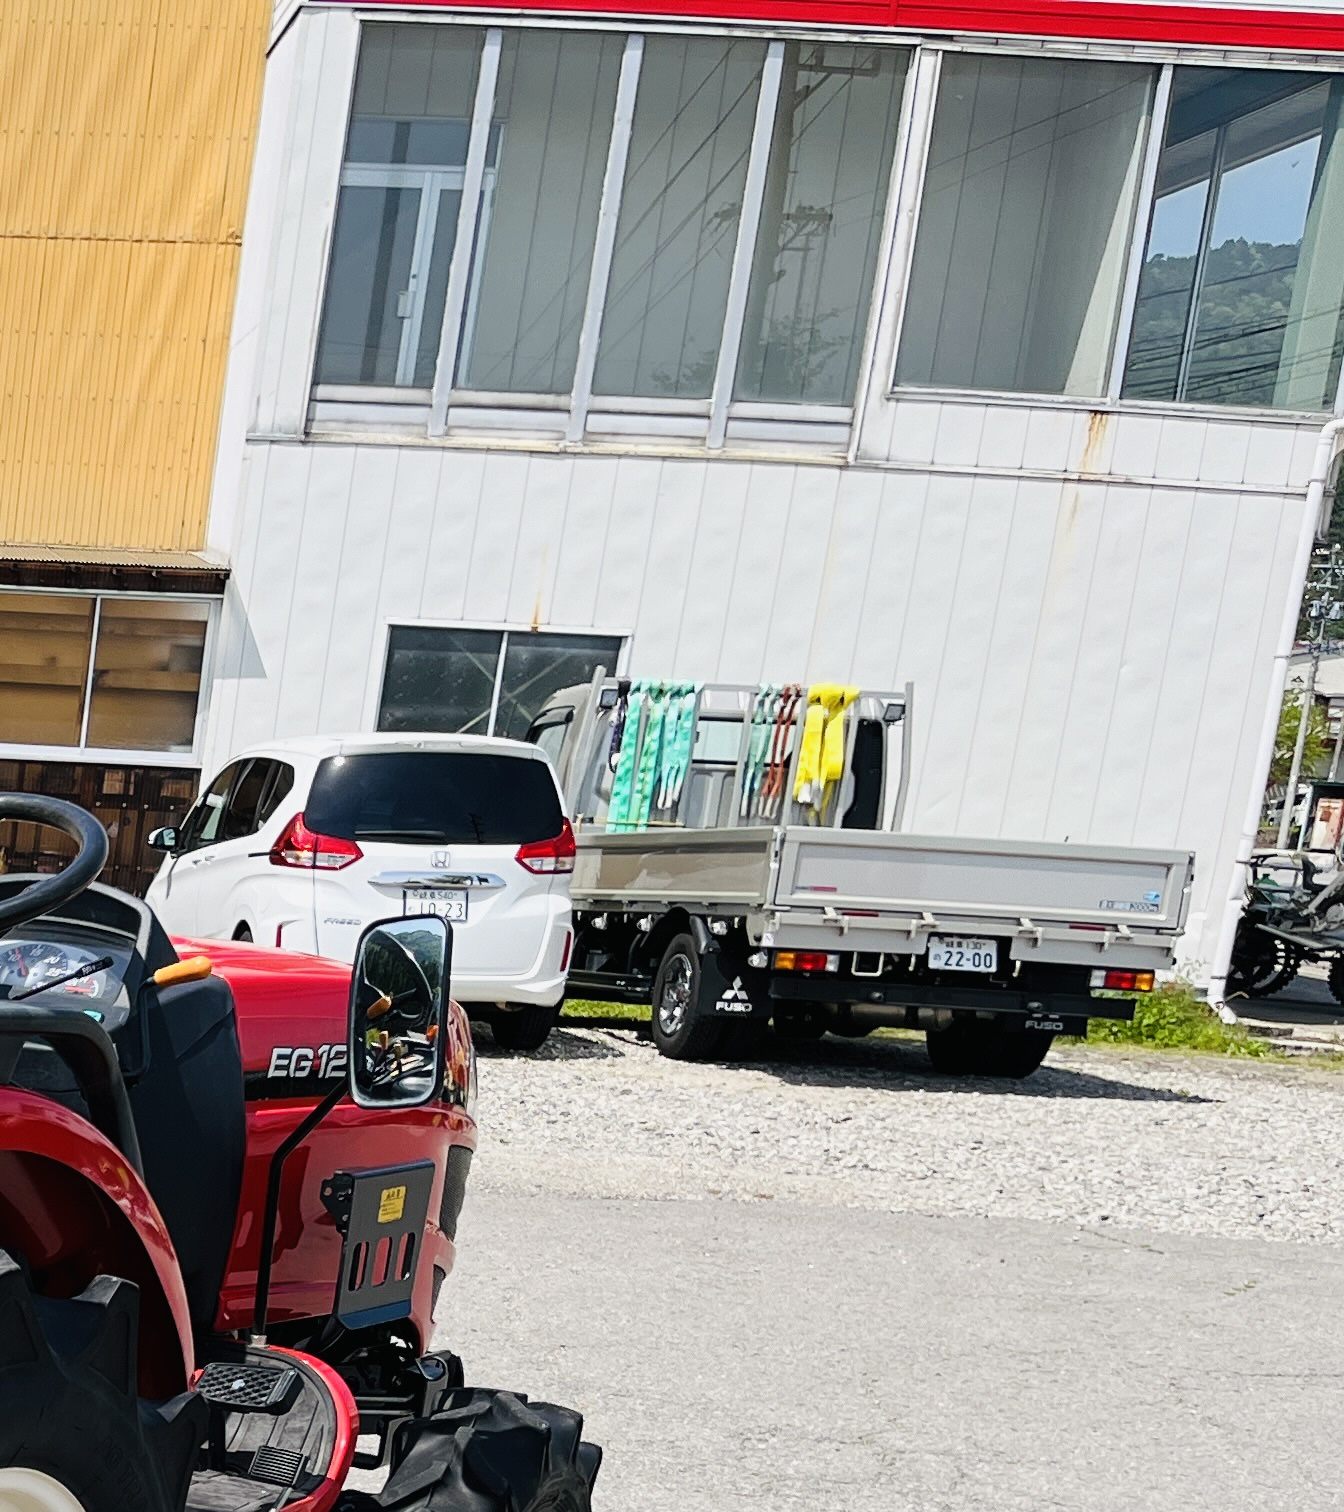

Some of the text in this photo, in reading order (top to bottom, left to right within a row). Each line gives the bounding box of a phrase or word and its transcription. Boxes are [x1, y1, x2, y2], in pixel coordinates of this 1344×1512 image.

[943, 950, 993, 969] 22-00
[715, 1001, 753, 1012] FUSO
[1025, 1020, 1064, 1031] FUSO
